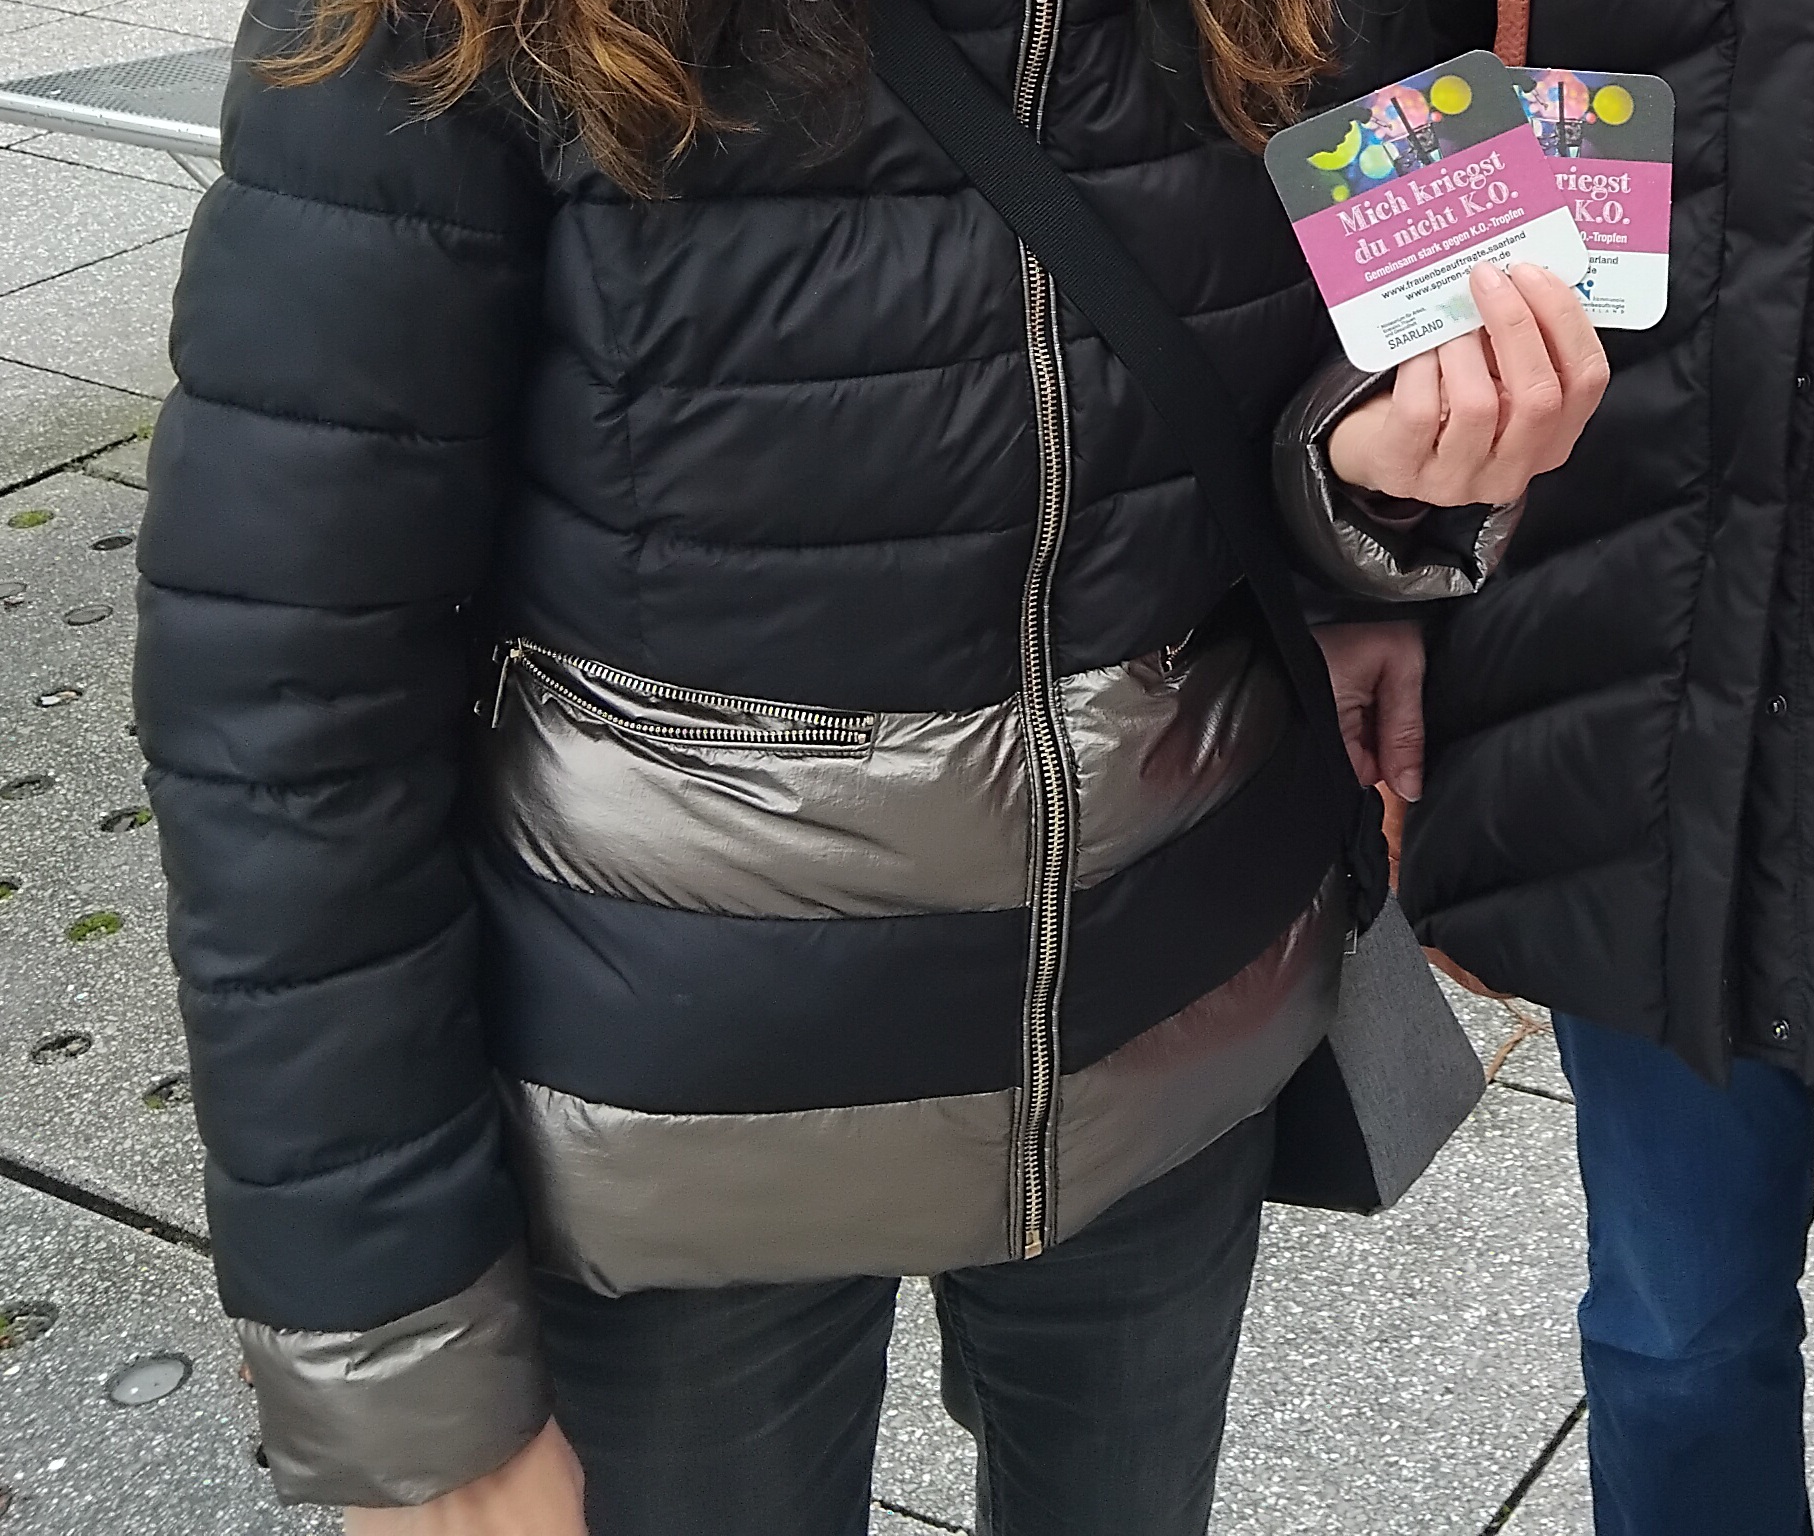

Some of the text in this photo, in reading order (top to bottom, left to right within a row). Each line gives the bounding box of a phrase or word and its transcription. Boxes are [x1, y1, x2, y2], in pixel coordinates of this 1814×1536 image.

[1337, 150, 1505, 237] Mich kriegst
[1555, 166, 1632, 201] riegst
[1355, 181, 1519, 265] du nicht K.O.
[1575, 199, 1630, 224] K.O.
[1581, 231, 1628, 244] O.-Tropfen
[1364, 253, 1418, 283] Gemeinsam
[1418, 243, 1442, 260] stark
[1443, 231, 1470, 251] gegen
[1589, 256, 1619, 265] arland
[1388, 318, 1444, 350] SAARLAND
